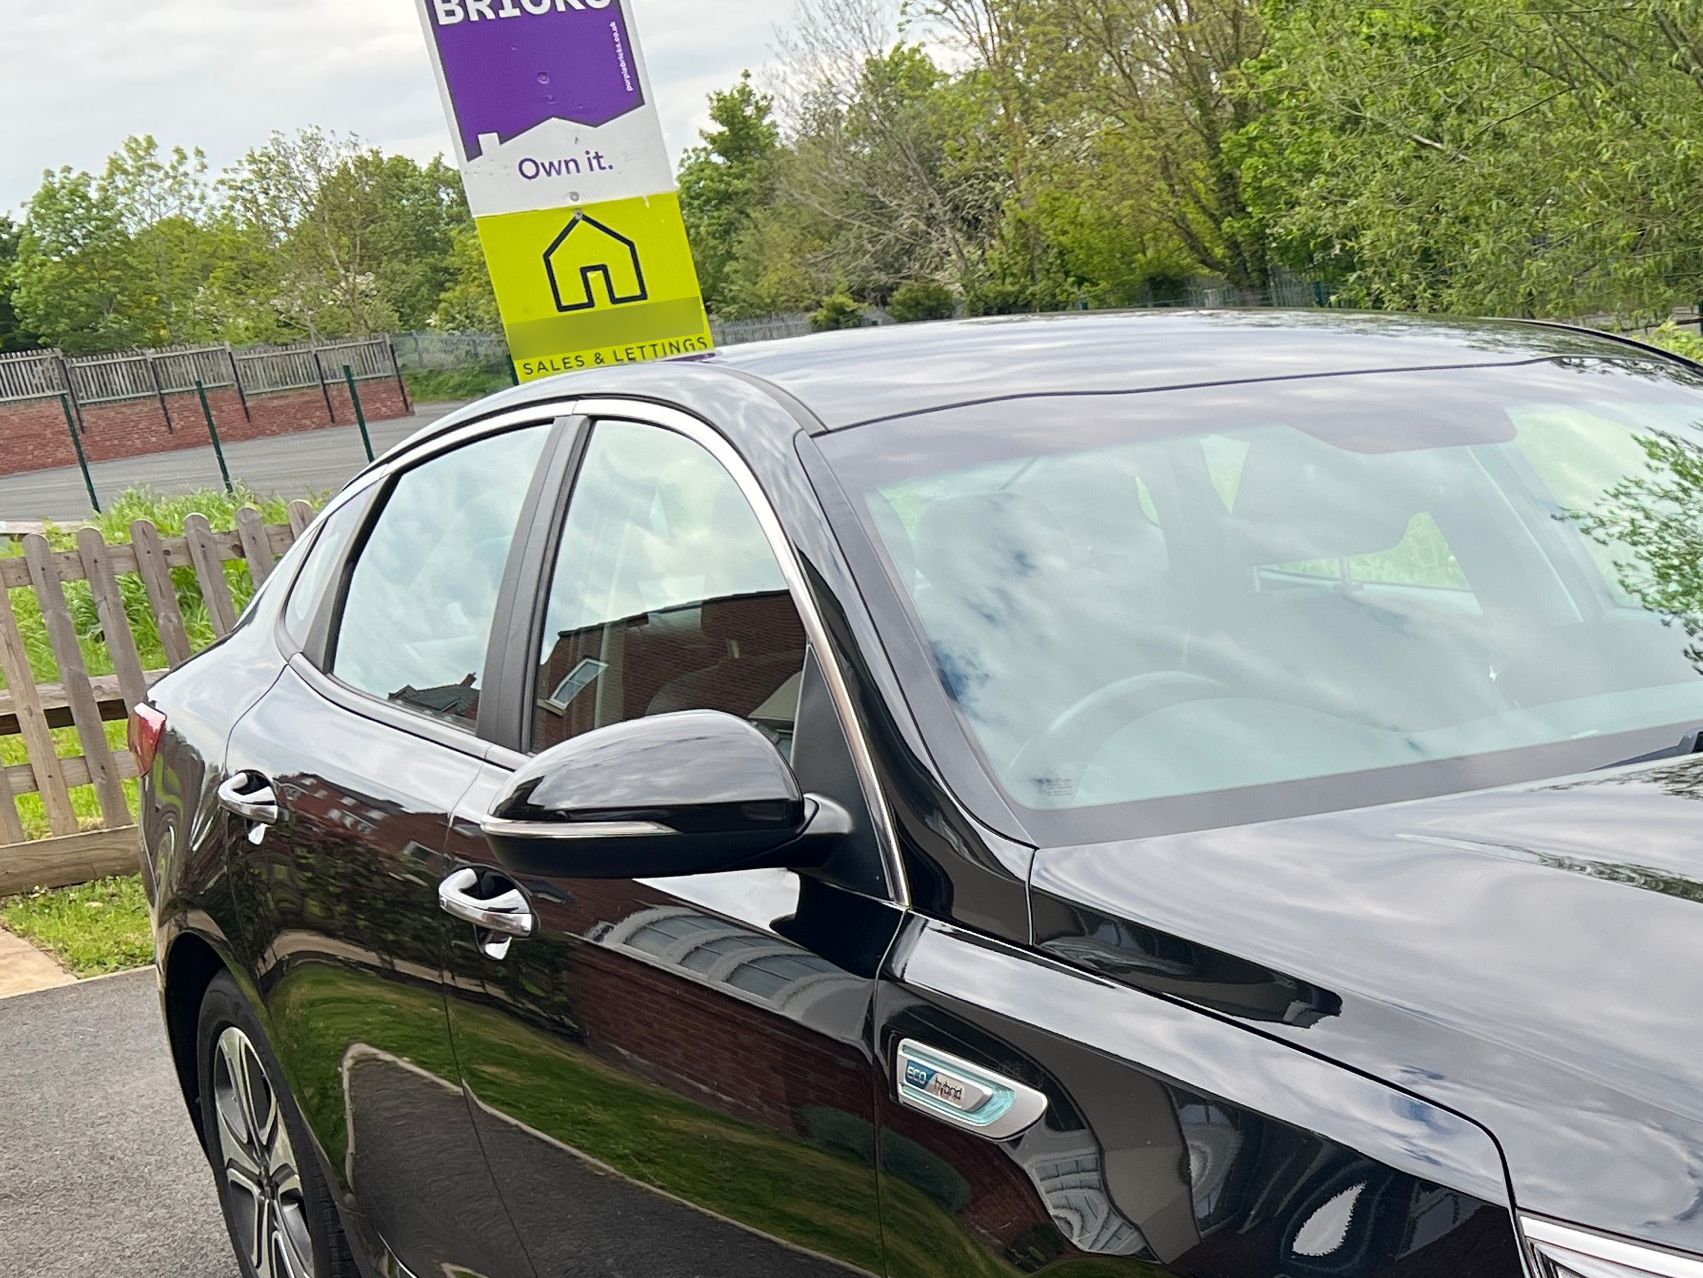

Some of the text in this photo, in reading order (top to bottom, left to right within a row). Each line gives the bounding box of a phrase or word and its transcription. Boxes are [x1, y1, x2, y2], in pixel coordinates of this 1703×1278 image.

[433, 0, 612, 25] BRI
[518, 150, 613, 181] Own it.
[522, 336, 708, 375] SALES & LETTINGS
[935, 1077, 962, 1101] hybrid
